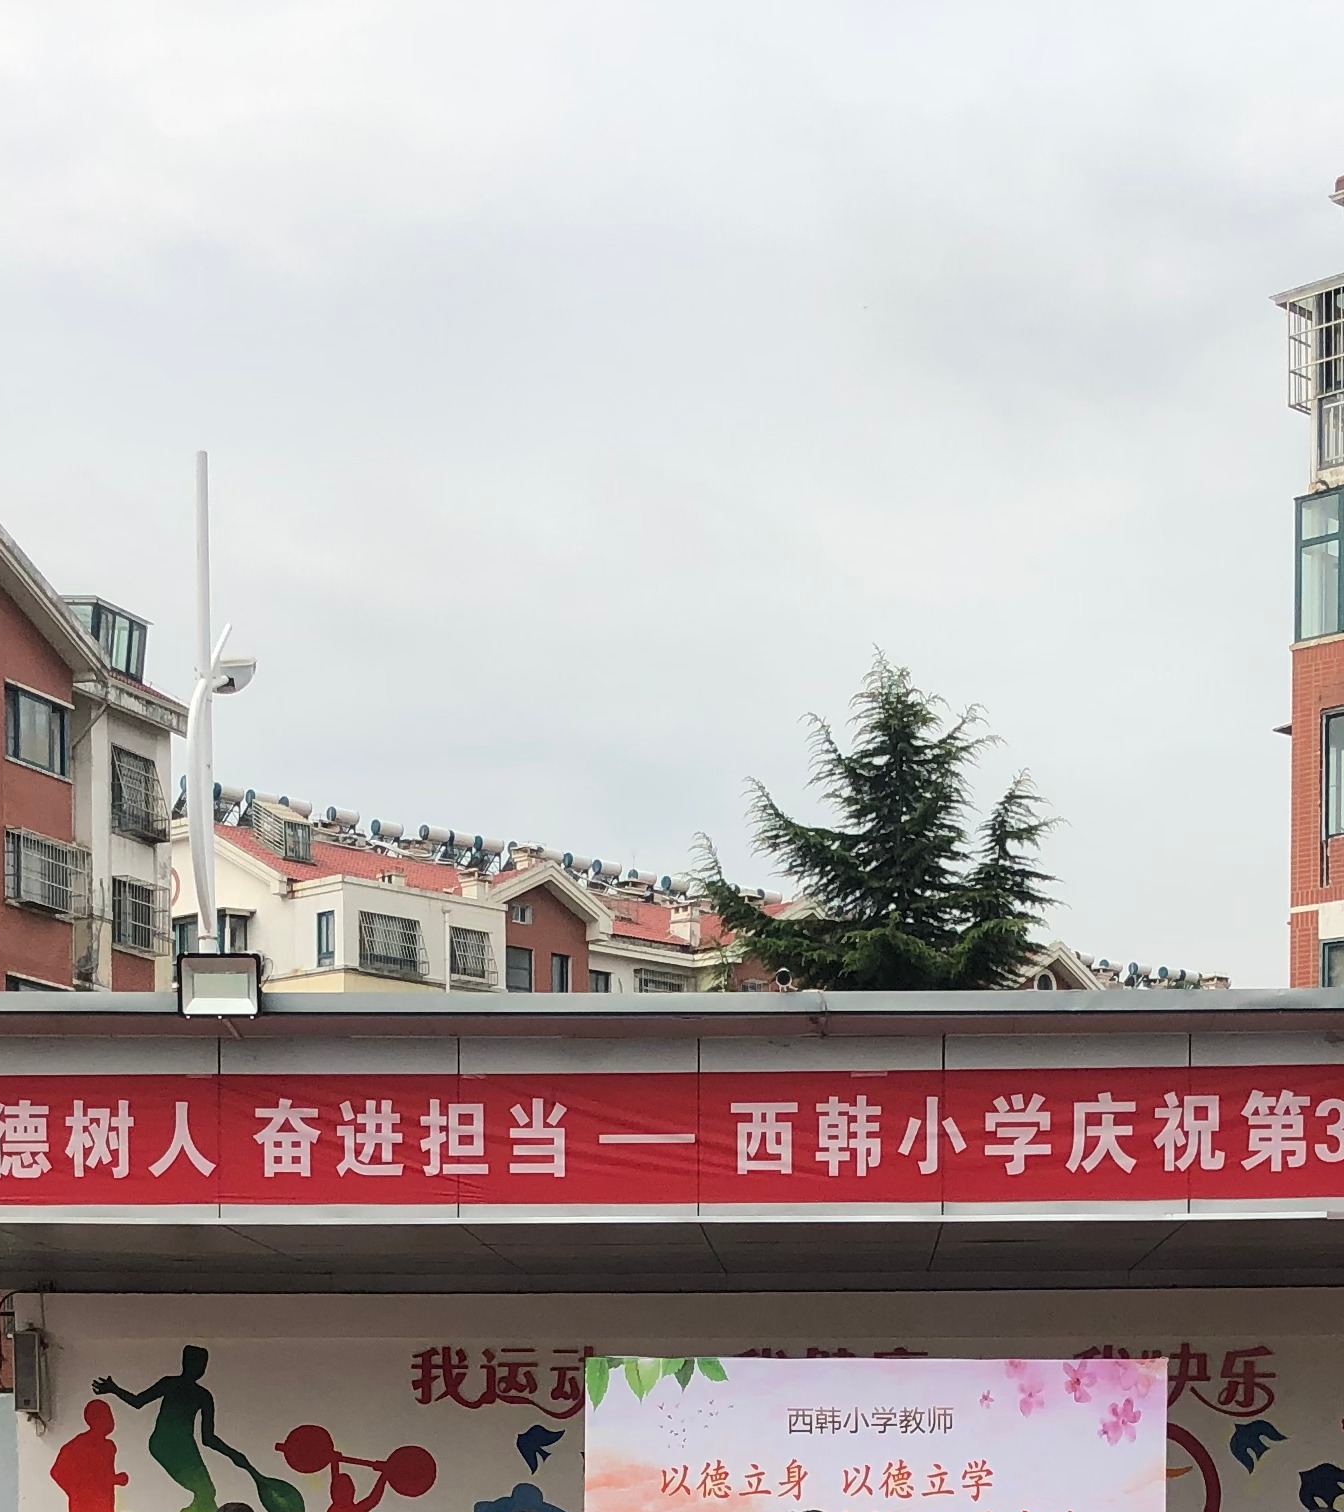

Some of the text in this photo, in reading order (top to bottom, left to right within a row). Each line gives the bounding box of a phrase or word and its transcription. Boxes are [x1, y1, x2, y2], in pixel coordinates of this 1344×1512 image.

[253, 1098, 566, 1178] 奋进担当
[787, 1406, 954, 1435] 西韩小学教师
[659, 1459, 994, 1501] 以德立身 以德立学
